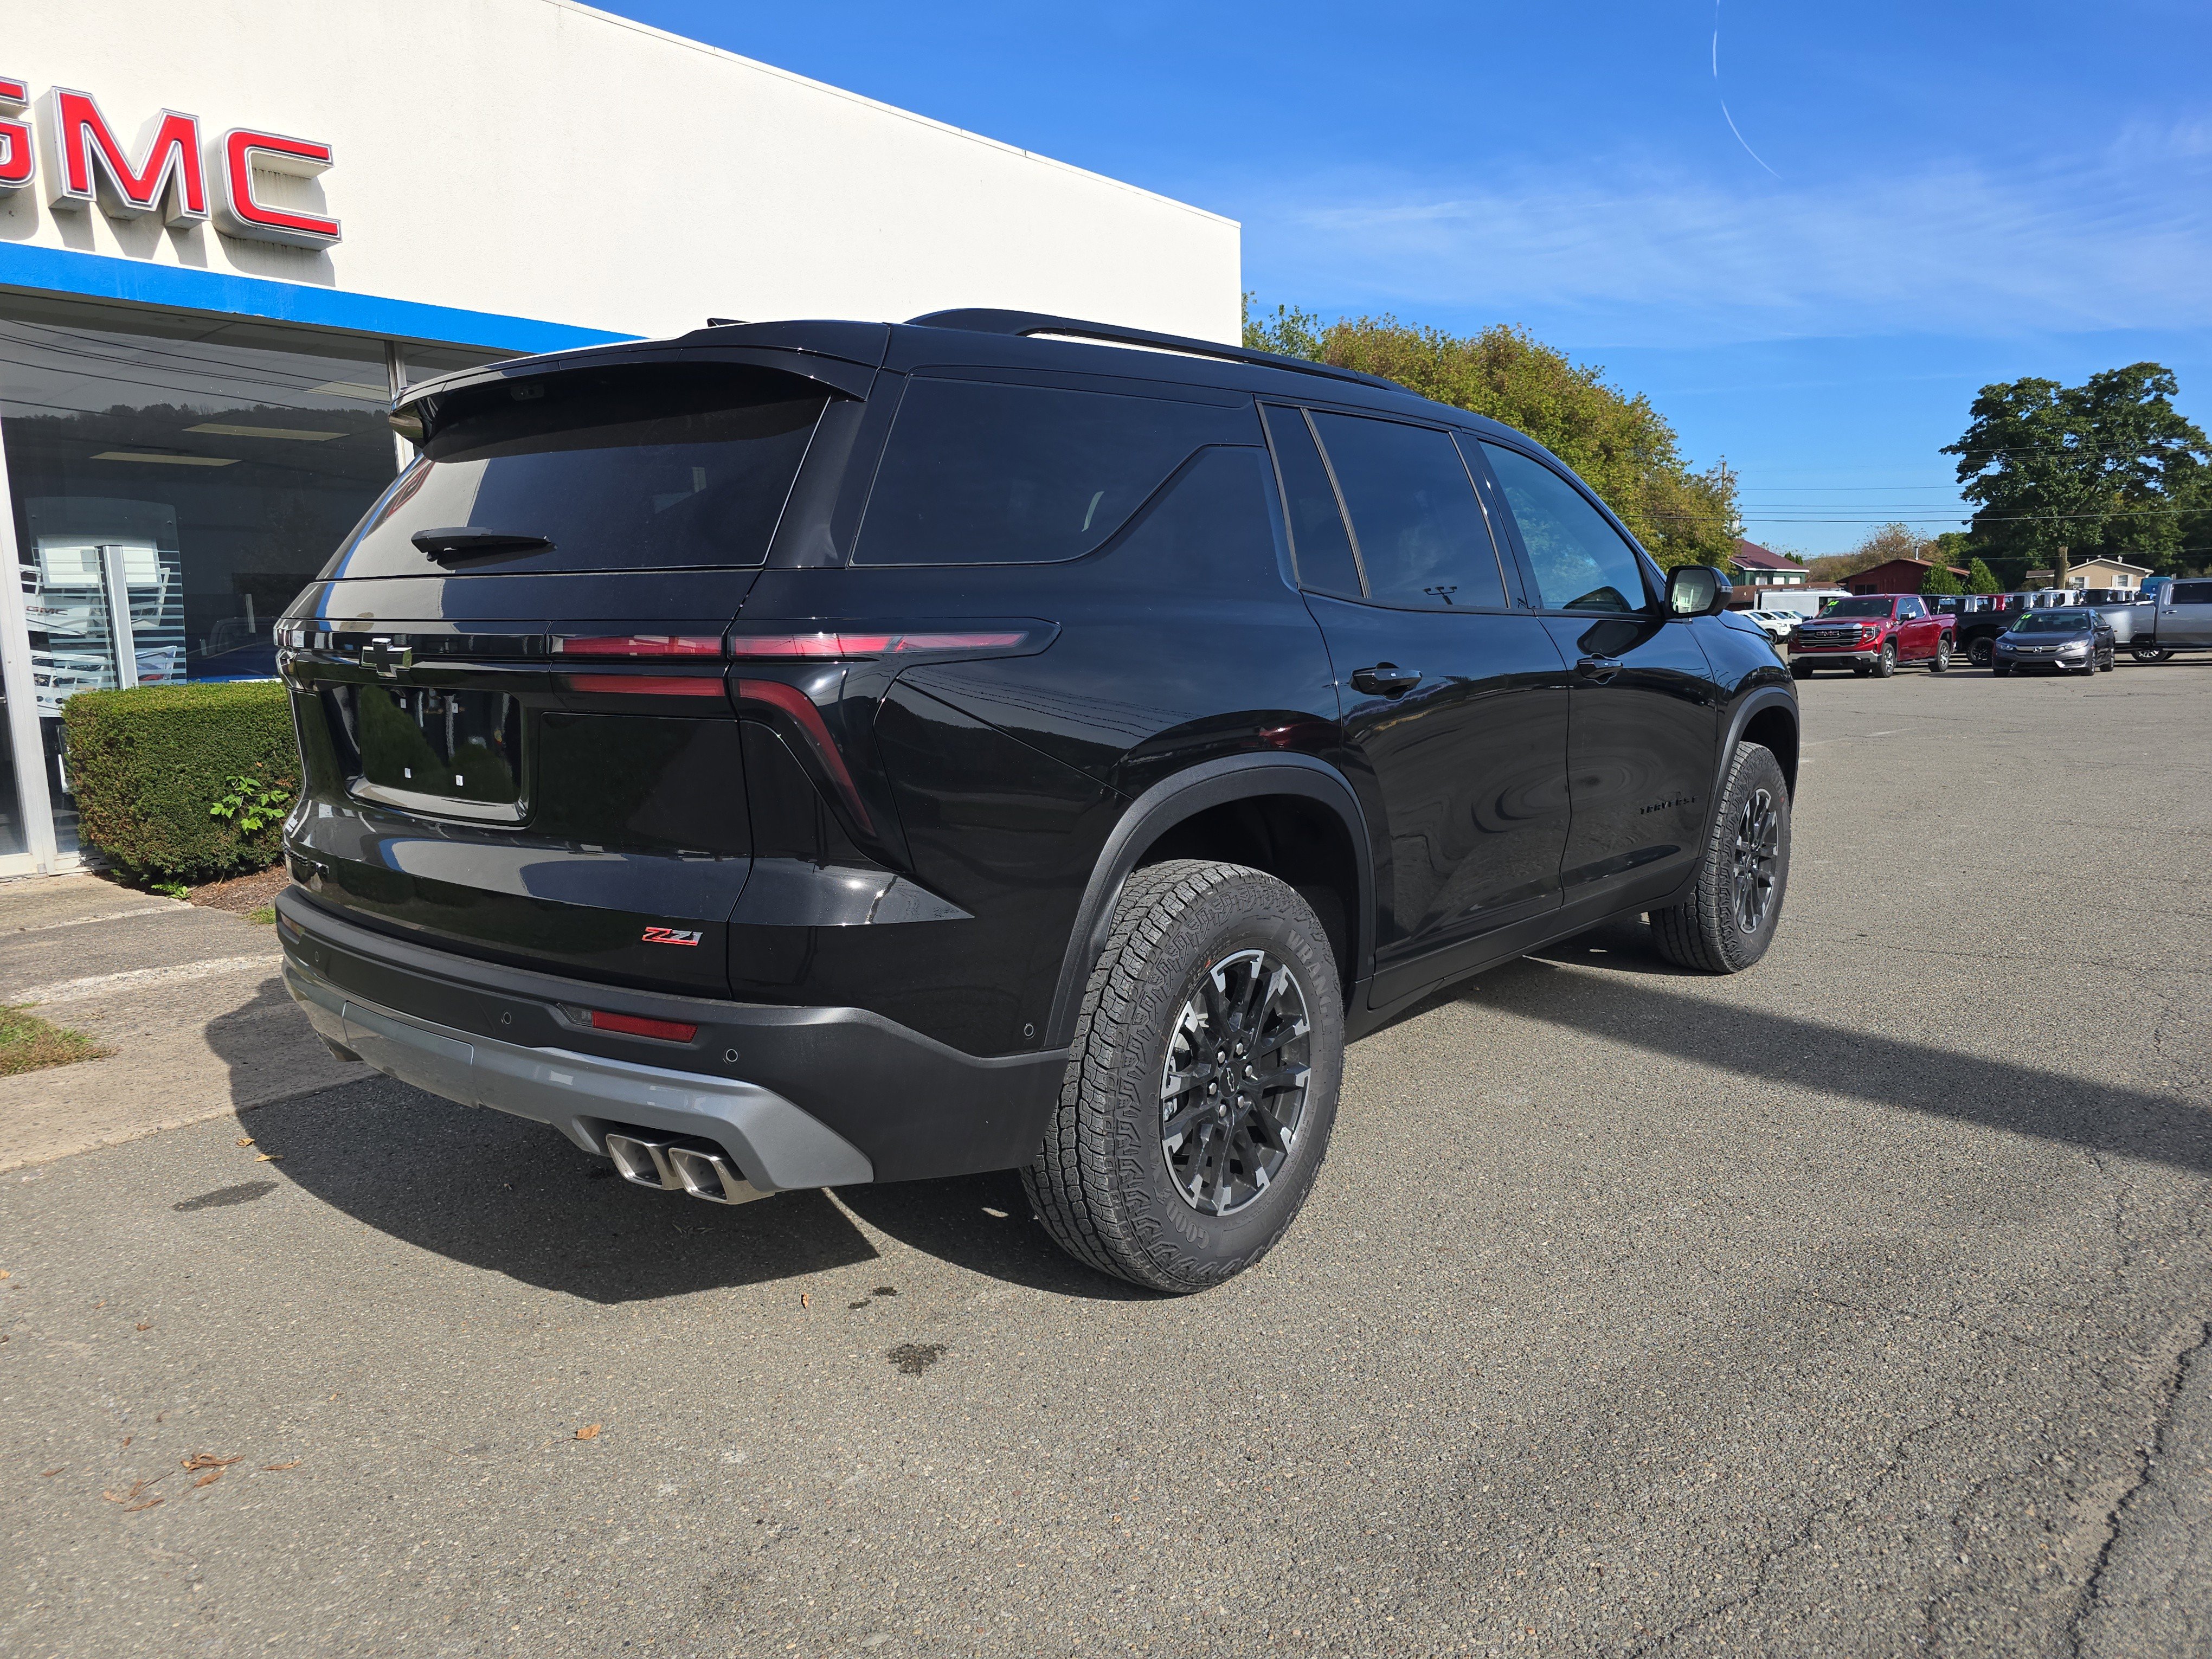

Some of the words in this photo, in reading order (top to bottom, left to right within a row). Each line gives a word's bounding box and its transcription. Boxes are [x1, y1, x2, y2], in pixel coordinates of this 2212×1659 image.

[26, 606, 68, 615] GMC
[641, 926, 703, 947] Z71
[1148, 1092, 1210, 1250] GOODYEAR
